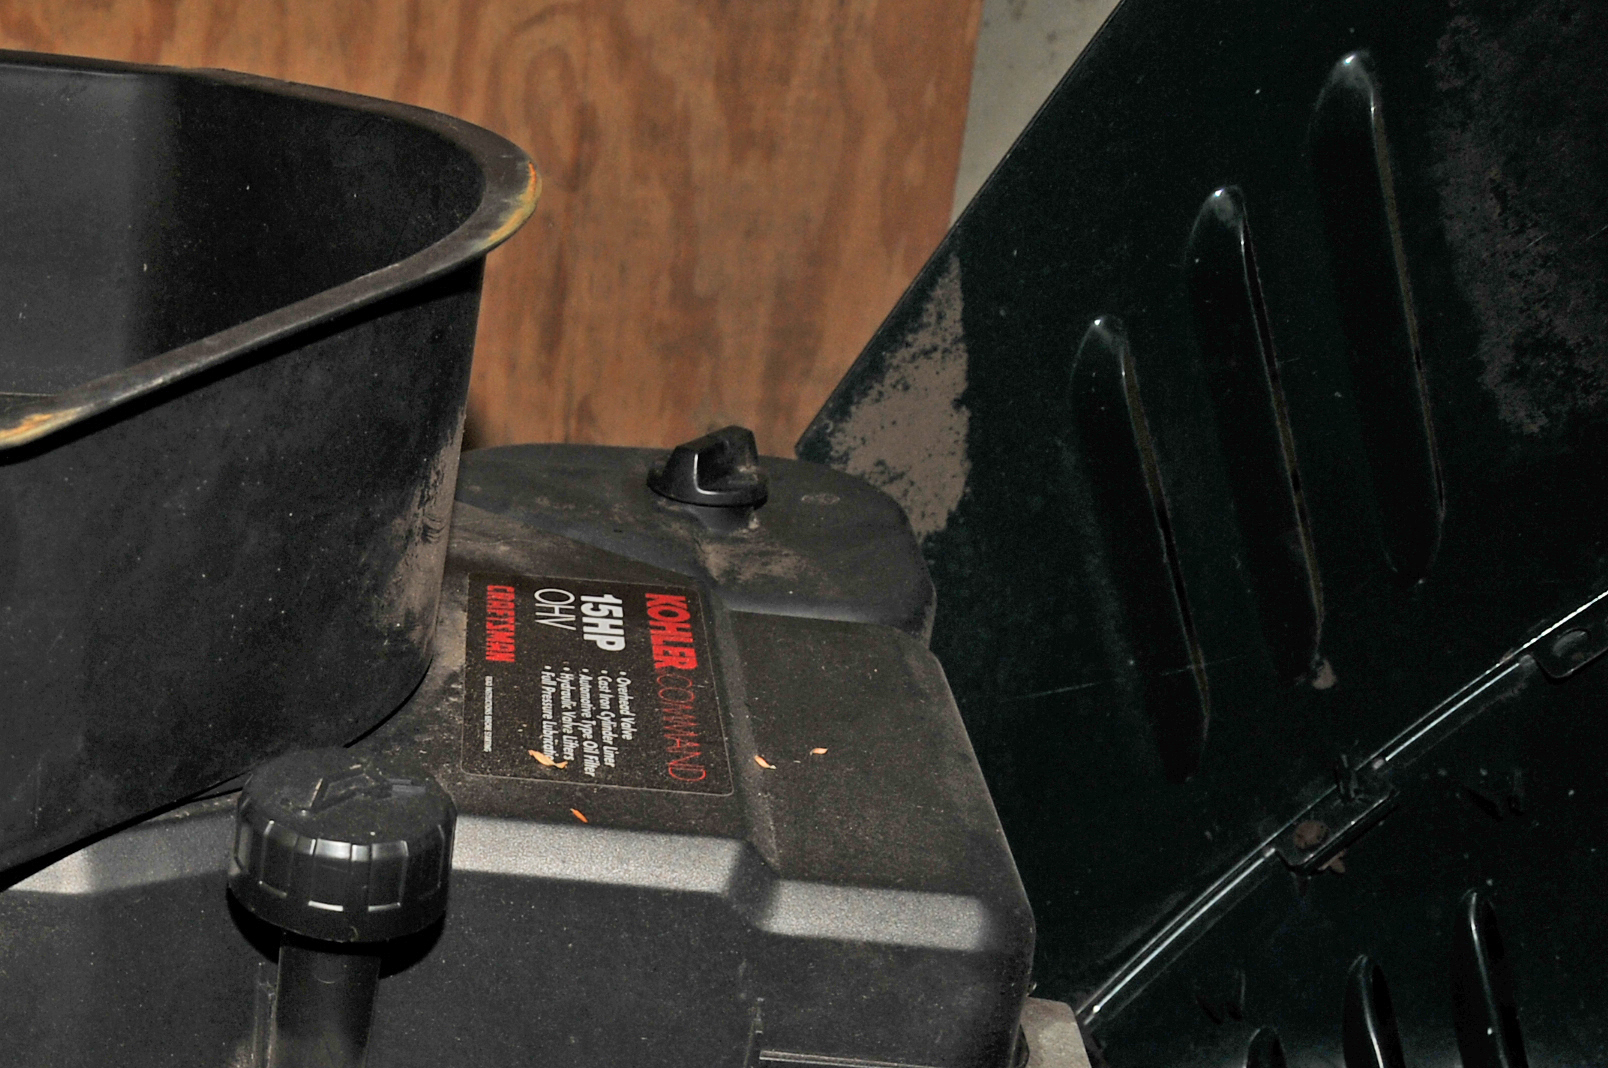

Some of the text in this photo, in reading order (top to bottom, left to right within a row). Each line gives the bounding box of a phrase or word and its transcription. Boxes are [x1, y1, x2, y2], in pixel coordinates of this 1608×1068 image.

[486, 585, 515, 662] CRAFTSMAN
[534, 588, 576, 631] OHV
[581, 594, 626, 651] 15HP
[541, 671, 559, 761] Full Pressure Lubricatio
[556, 673, 579, 760] Hydraulic Valve Lifters
[577, 674, 600, 777] Automotive Type Oil Filter
[596, 676, 619, 768] Cast Iron Cylinder Liner
[616, 677, 637, 740] Overhead Valve
[645, 593, 706, 782] KOHLER COMMAND
